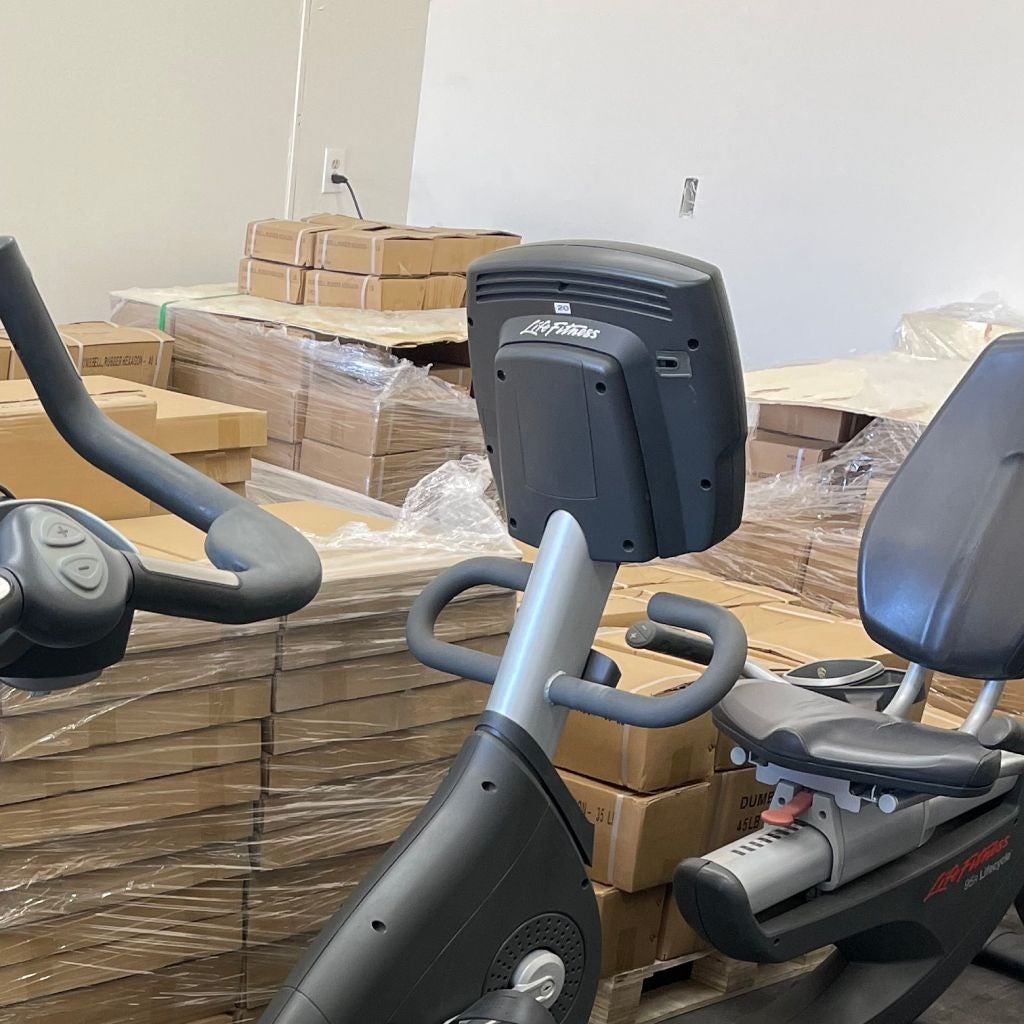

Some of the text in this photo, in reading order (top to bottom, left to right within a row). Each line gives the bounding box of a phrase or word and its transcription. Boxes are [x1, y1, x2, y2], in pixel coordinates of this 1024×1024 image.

[557, 304, 569, 312] 20
[519, 319, 601, 339] Life Fitness
